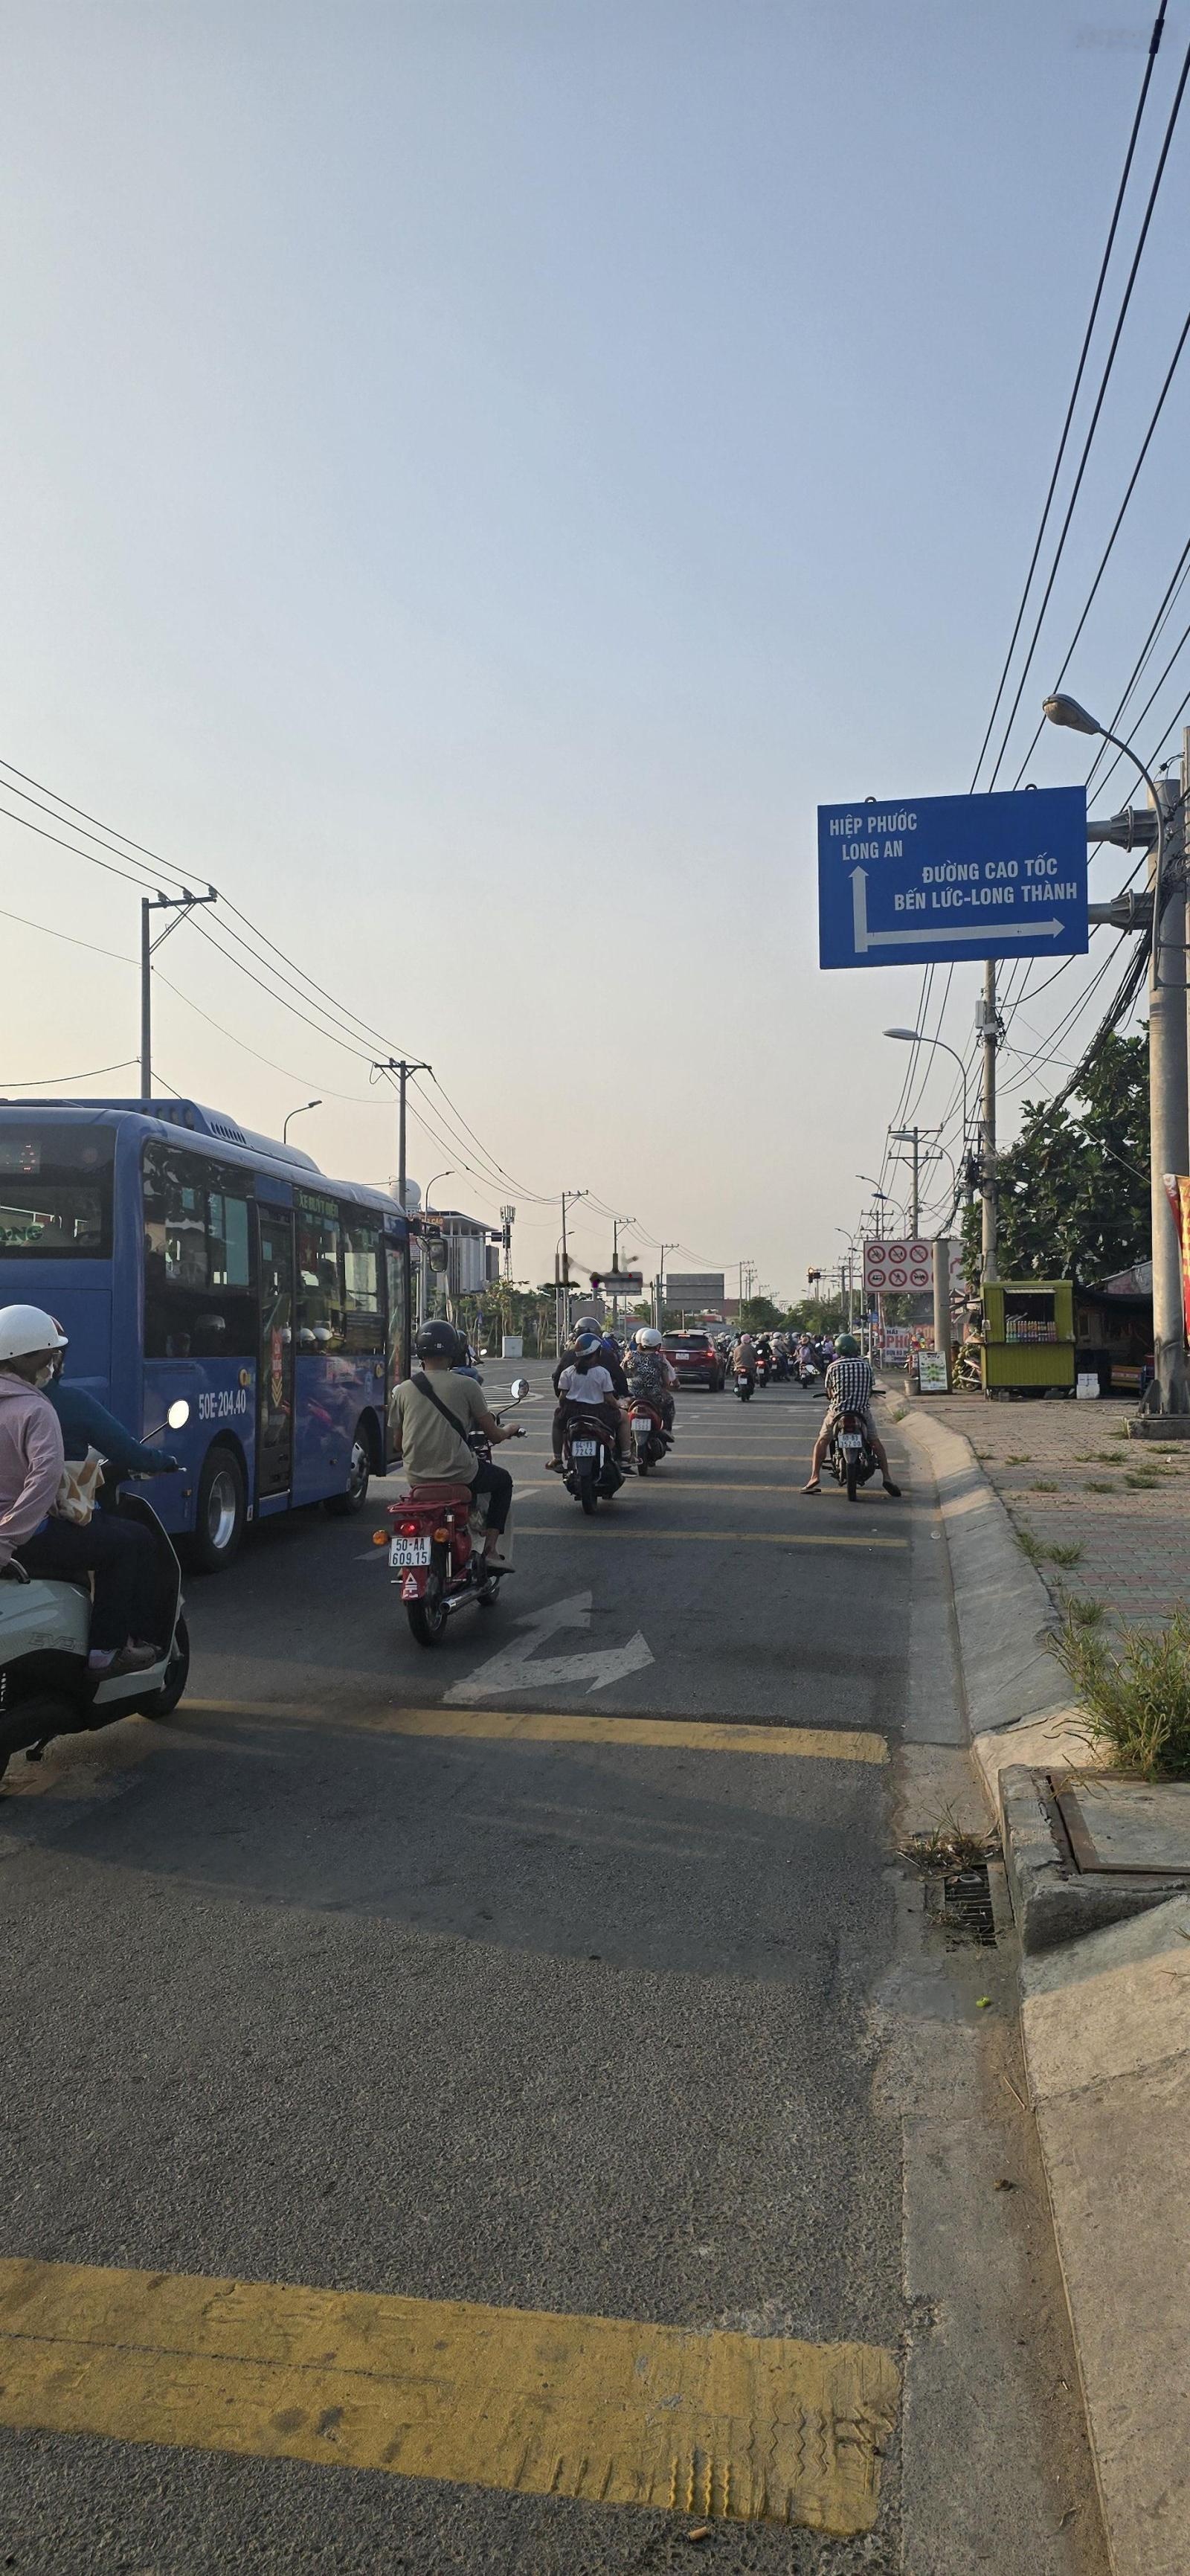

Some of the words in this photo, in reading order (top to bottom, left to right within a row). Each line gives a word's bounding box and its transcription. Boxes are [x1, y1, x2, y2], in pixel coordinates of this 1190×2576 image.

[829, 815, 863, 838] HIỆP
[867, 808, 917, 833] PHƯỚC
[842, 842, 879, 861] LONG
[884, 840, 903, 858] AN
[922, 860, 980, 883] ĐƯỜNG
[985, 861, 1018, 879] CAO
[1024, 852, 1058, 876] TỐC
[894, 887, 926, 910] BẾN
[932, 886, 1014, 908] LỨC-LONG
[1021, 881, 1077, 902] THÀNH
[199, 1389, 246, 1420] 50E-204.40
[392, 1552, 428, 1565] 609.15
[396, 1538, 425, 1552] 50-AA
